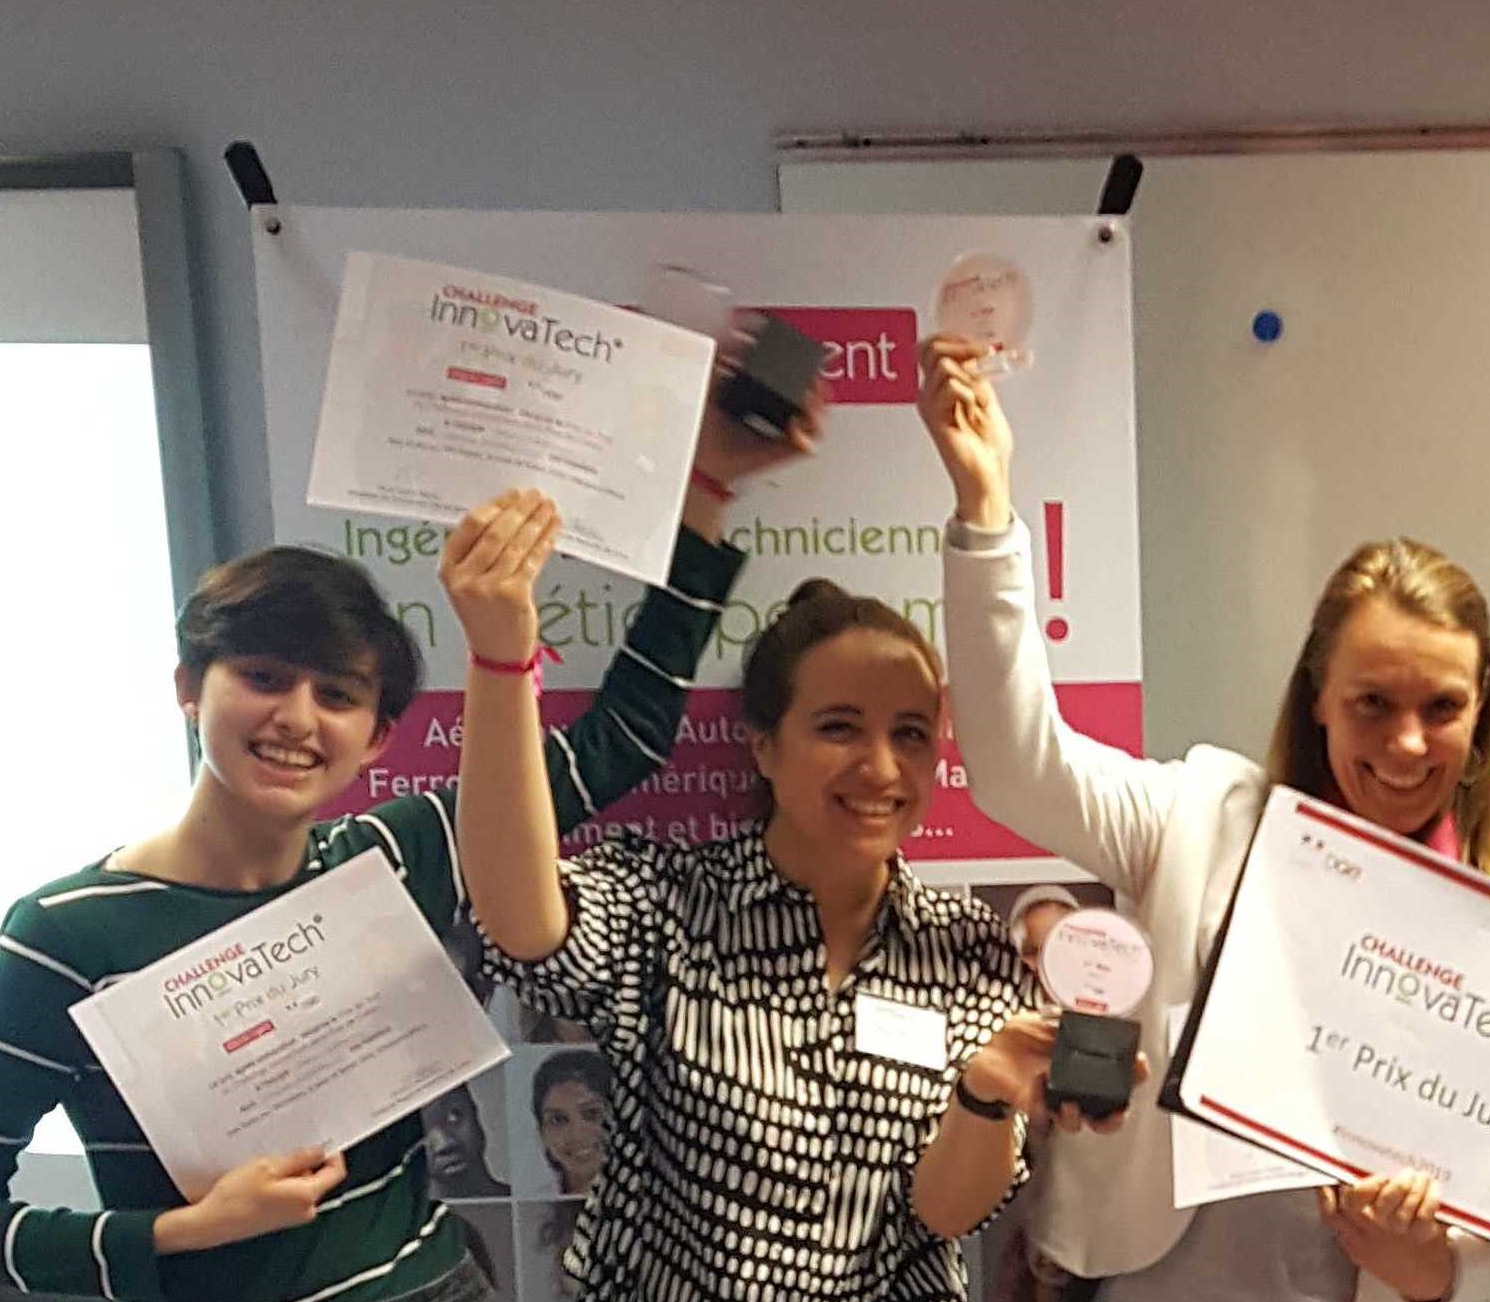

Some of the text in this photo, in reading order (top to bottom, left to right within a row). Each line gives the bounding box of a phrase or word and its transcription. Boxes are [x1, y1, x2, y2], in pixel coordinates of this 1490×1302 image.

[163, 942, 246, 993] CHALLENGE
[1359, 933, 1467, 991] CHALLENGE
[1304, 1024, 1351, 1054] 1er
[1352, 1044, 1413, 1093] Prix
[1417, 1072, 1459, 1109] du
